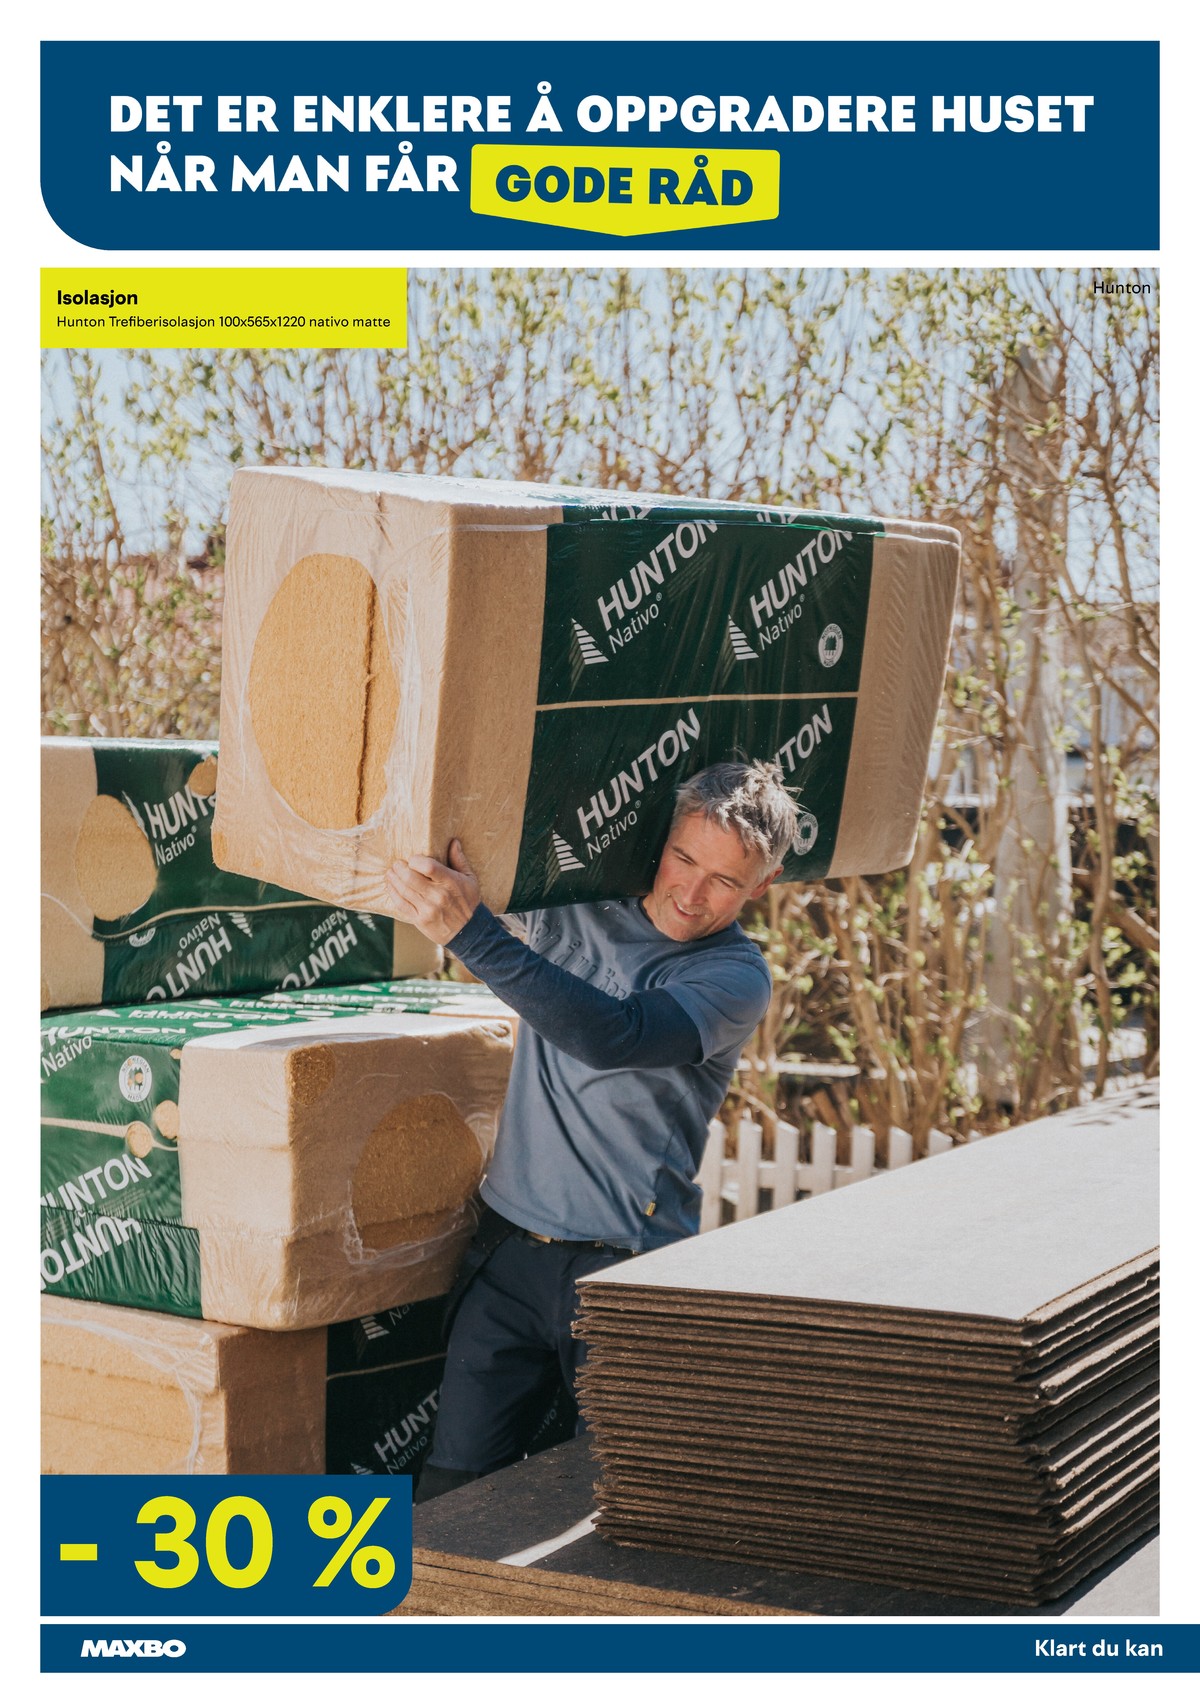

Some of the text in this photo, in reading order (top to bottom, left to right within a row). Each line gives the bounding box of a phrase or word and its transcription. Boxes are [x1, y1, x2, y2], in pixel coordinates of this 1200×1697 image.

[111, 81, 1094, 132] DET ER ENKLERE Å OPPGRADERE HUSET
[111, 141, 459, 192] NÅR MAN FÅR
[496, 158, 753, 206] GODE RÅD
[597, 519, 718, 631] HUNTON
[749, 531, 854, 628] HUNTON
[577, 707, 701, 839] HUNTON
[81, 1640, 186, 1657] MAXBO
[1035, 1638, 1163, 1657] Klart du kan
